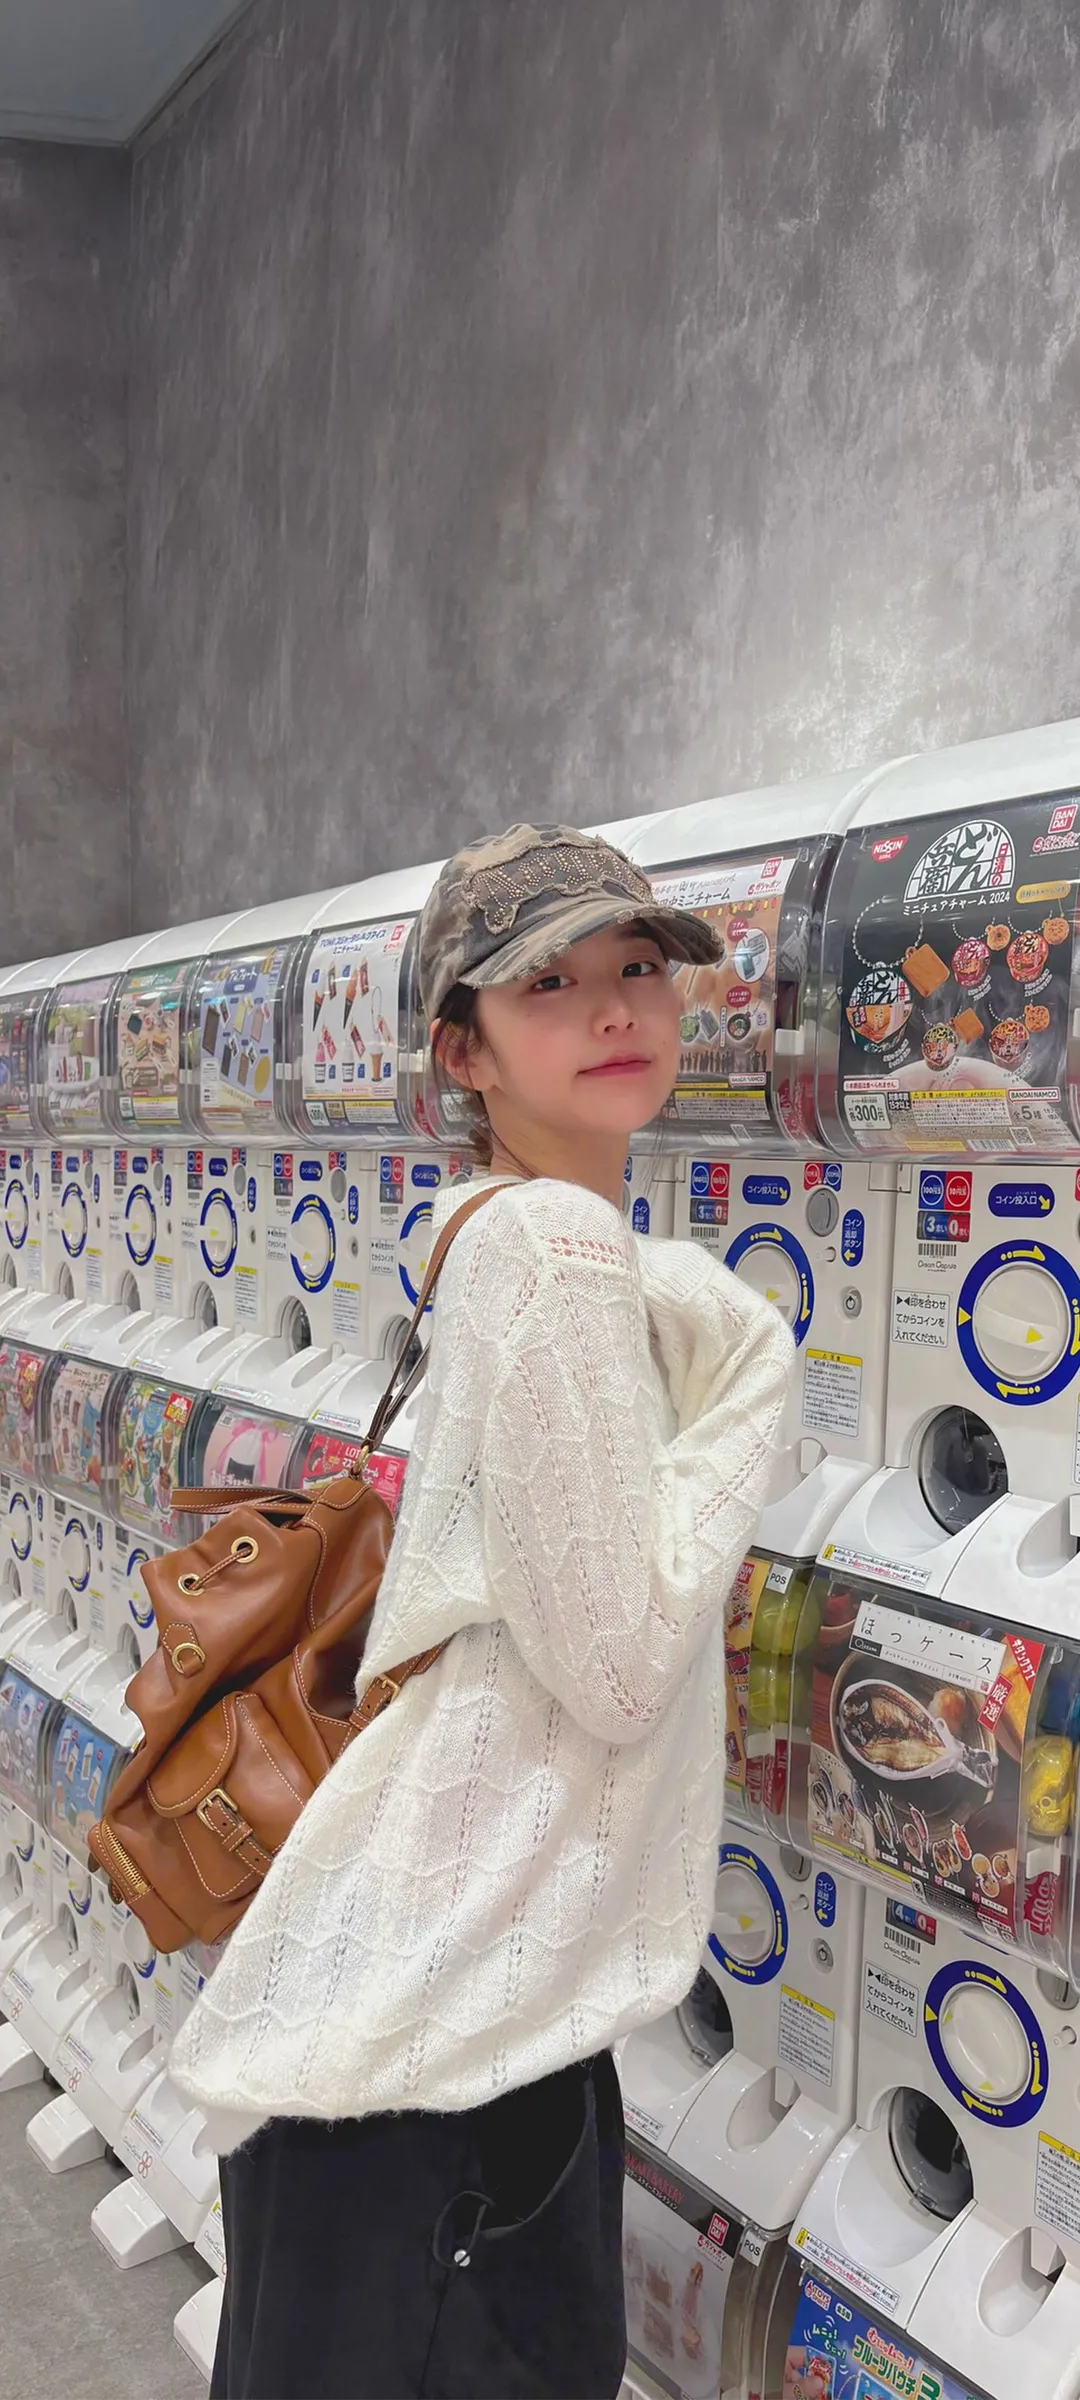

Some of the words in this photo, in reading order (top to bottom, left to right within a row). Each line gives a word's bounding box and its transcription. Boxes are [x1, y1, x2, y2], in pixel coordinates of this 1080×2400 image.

[873, 840, 904, 854] NISSIN
[903, 896, 987, 916] ミニチュアチャーム
[988, 891, 1011, 904] 2024
[747, 1185, 778, 1195] コイン投入口
[995, 1195, 1037, 1205] コイン投入口
[844, 1218, 862, 1228] コイン
[844, 1239, 862, 1249] ボタン
[910, 1297, 946, 1310] 印を合わせ
[896, 1313, 945, 1328] てからコインを
[895, 1329, 945, 1345] 入れてください。
[769, 1572, 787, 1585] POS
[982, 1682, 1009, 1723] 厳選
[817, 1878, 834, 1891] コイン
[867, 1984, 914, 2018] てからコインを
[866, 2000, 914, 2034] 入れてください。
[744, 2239, 761, 2257] POS
[854, 2335, 917, 2396] フルーツパウチ
